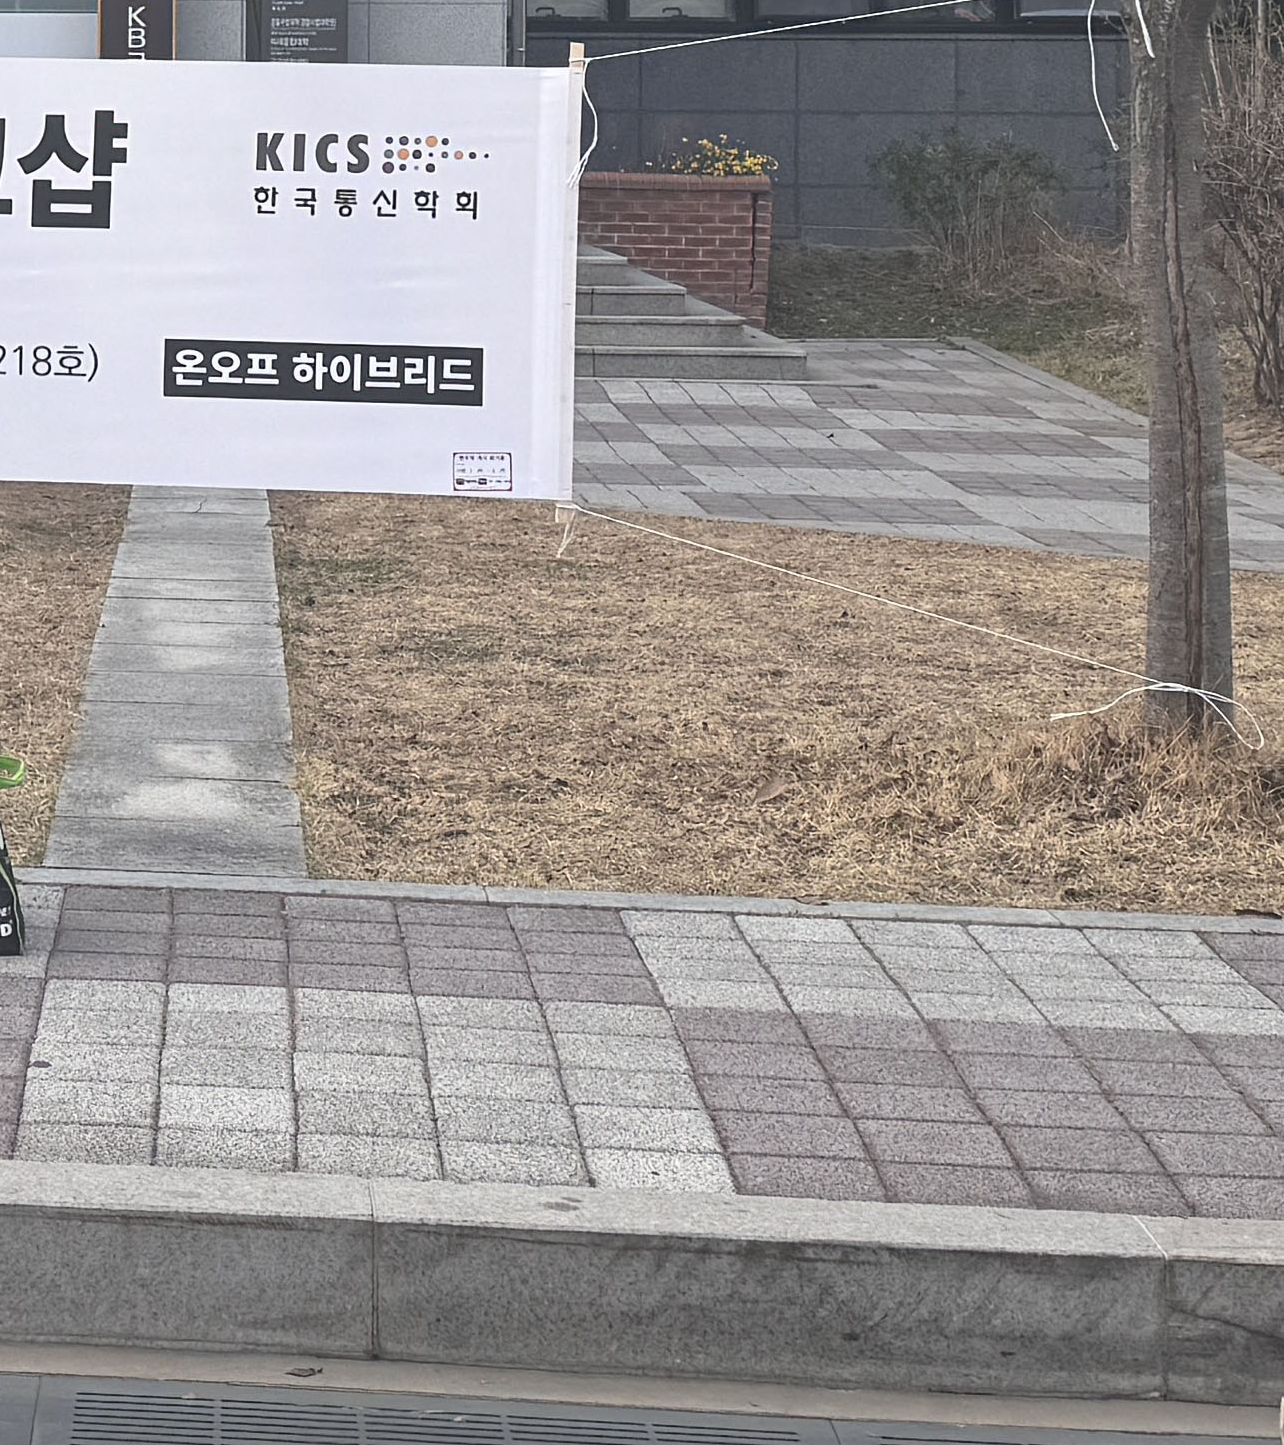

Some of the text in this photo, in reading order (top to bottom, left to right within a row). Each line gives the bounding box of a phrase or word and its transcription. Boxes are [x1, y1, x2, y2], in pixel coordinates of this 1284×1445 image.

[255, 132, 370, 174] KICS
[253, 186, 478, 220] 한국통신학회
[171, 349, 475, 394] 온오프 하이브리드
